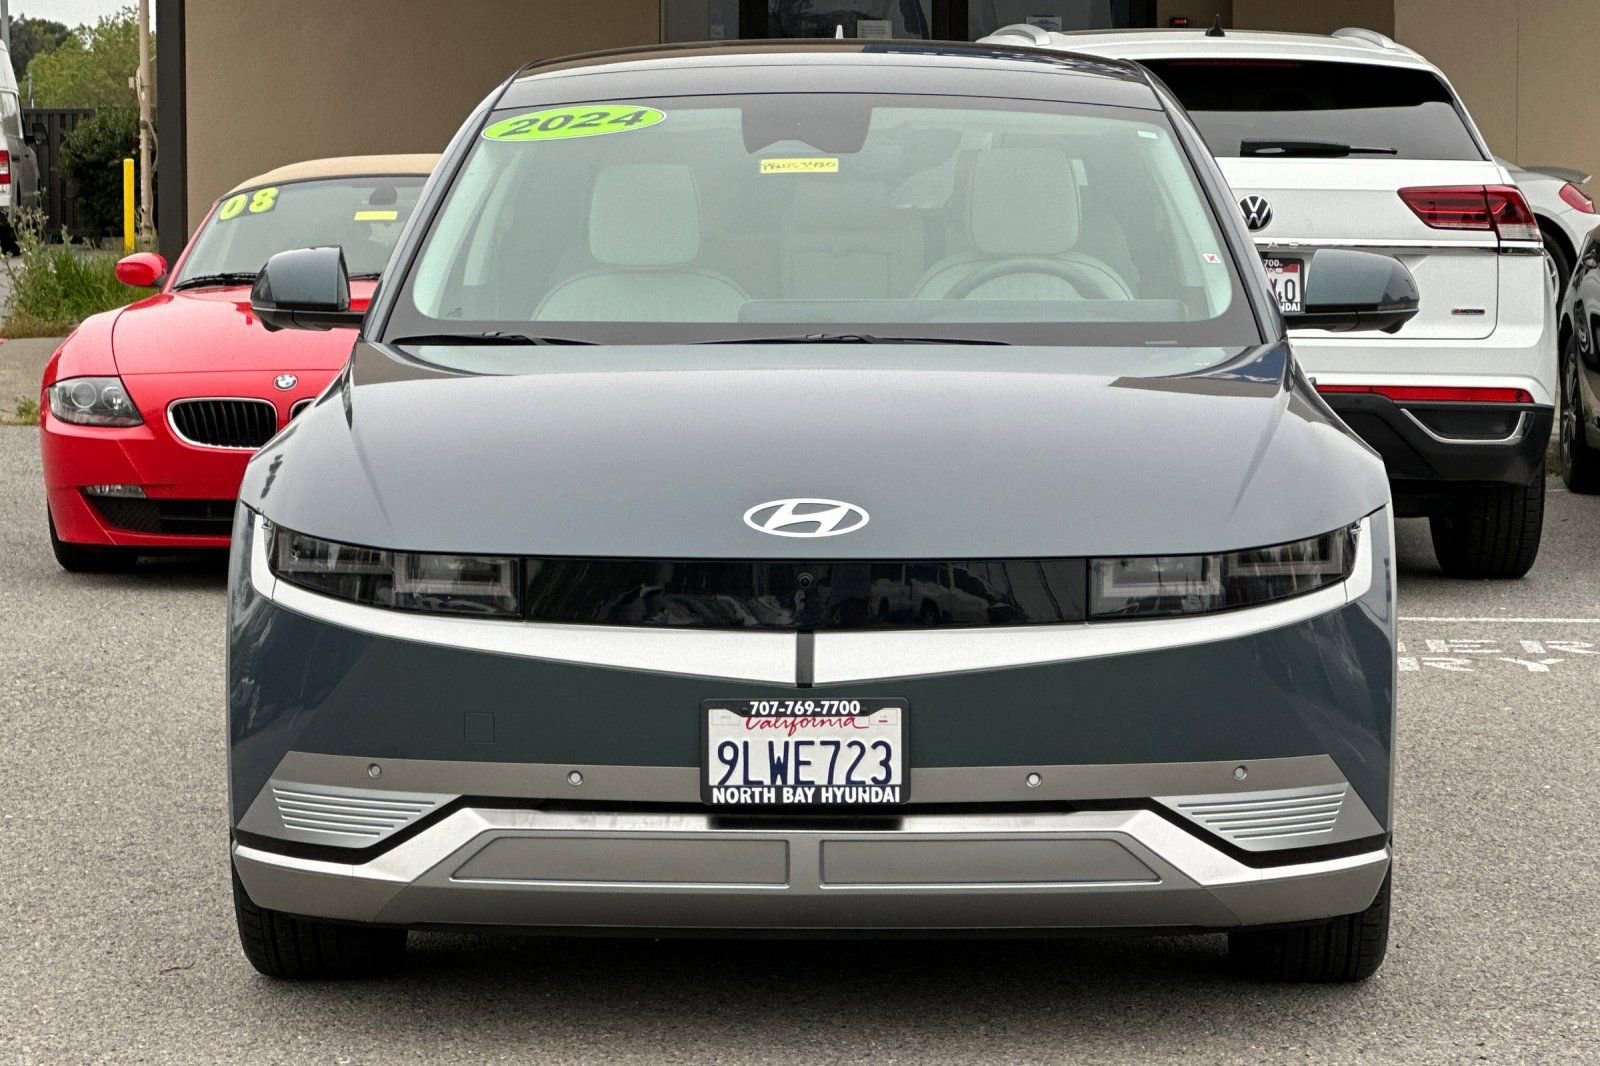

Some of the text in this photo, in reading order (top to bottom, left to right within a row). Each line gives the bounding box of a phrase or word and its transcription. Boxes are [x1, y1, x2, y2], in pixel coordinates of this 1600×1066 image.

[496, 109, 651, 137] 2024
[219, 186, 279, 221] 08
[749, 700, 861, 715] 707-769-7700
[745, 715, 870, 737] California
[717, 740, 892, 785] 9LWE723
[712, 787, 901, 804] NORTH BAY HYUNDAI
